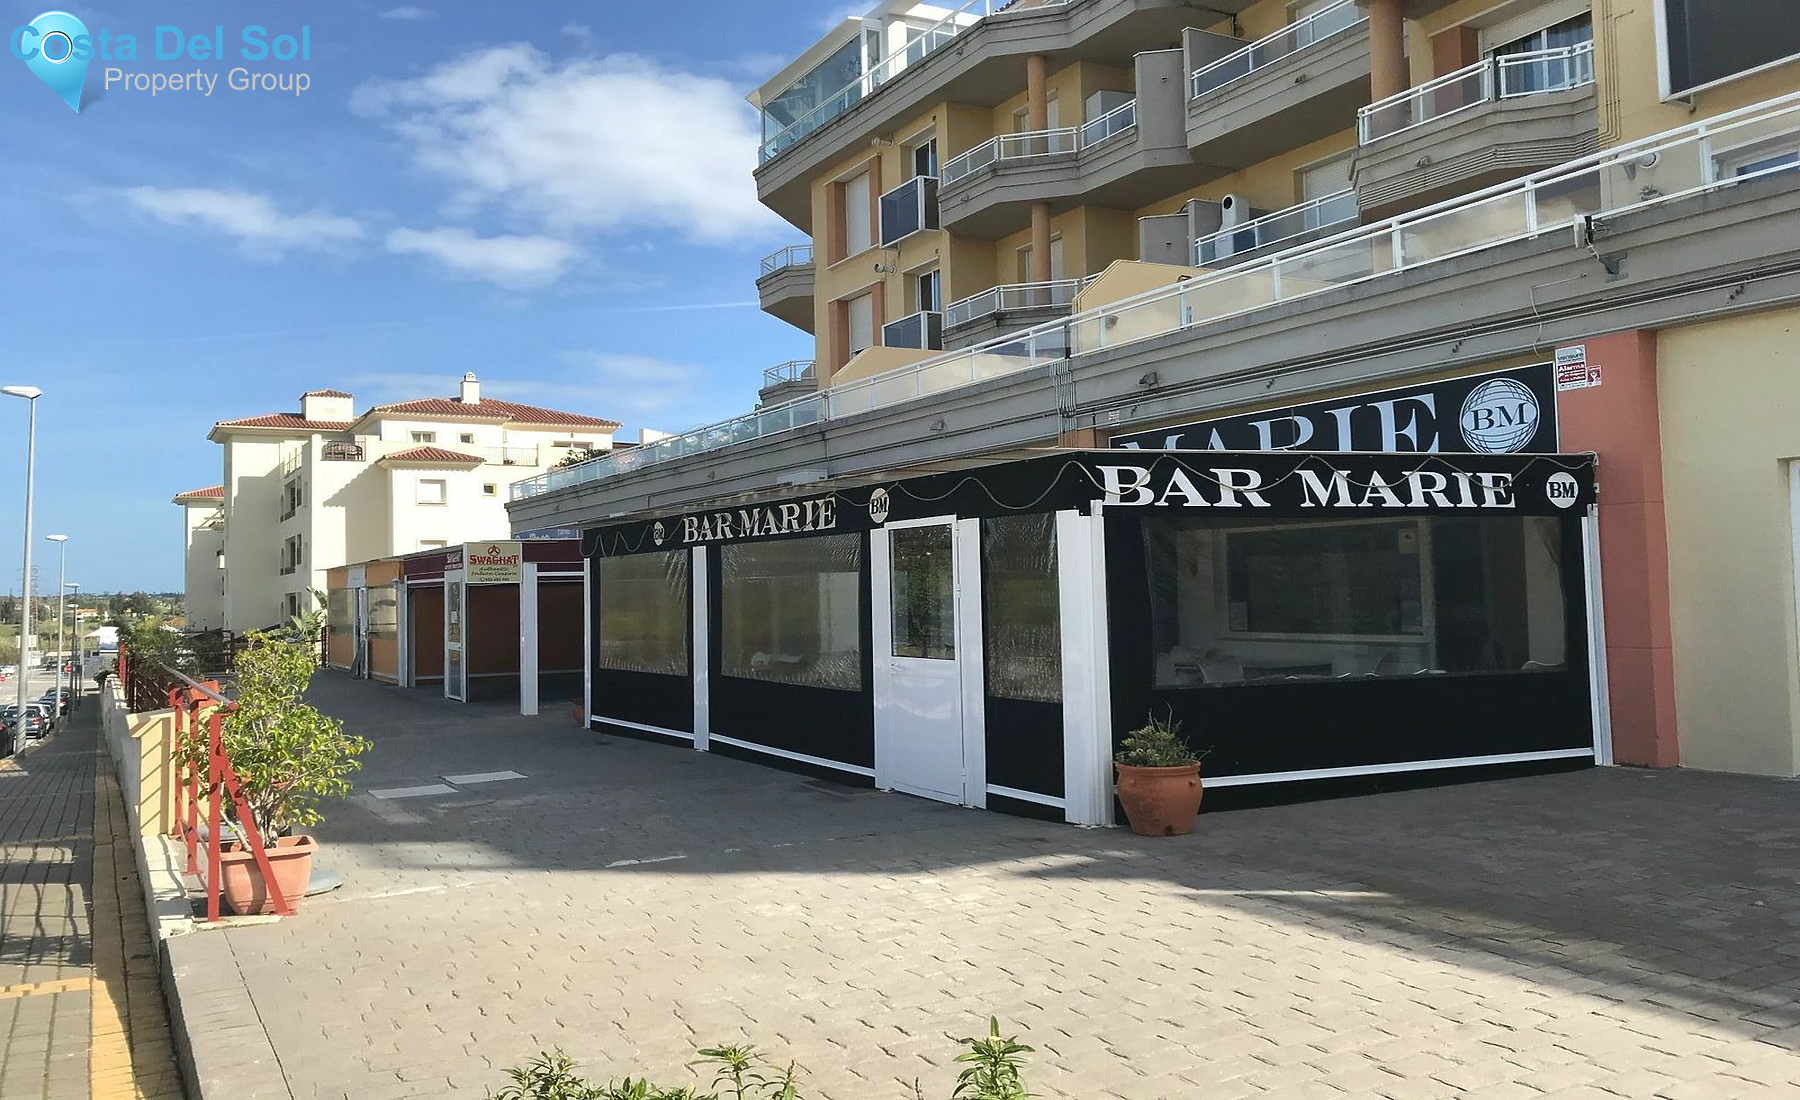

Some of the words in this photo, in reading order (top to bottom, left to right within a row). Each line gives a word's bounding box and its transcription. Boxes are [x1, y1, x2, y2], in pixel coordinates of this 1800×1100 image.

[1470, 402, 1528, 431] BM
[1095, 465, 1271, 507] BAR
[1294, 470, 1516, 508] MARIE
[1547, 482, 1576, 499] BM
[870, 496, 889, 514] BM
[682, 513, 733, 543] BAR
[739, 497, 837, 538] MARIE
[469, 554, 519, 565] SWAGHAT
